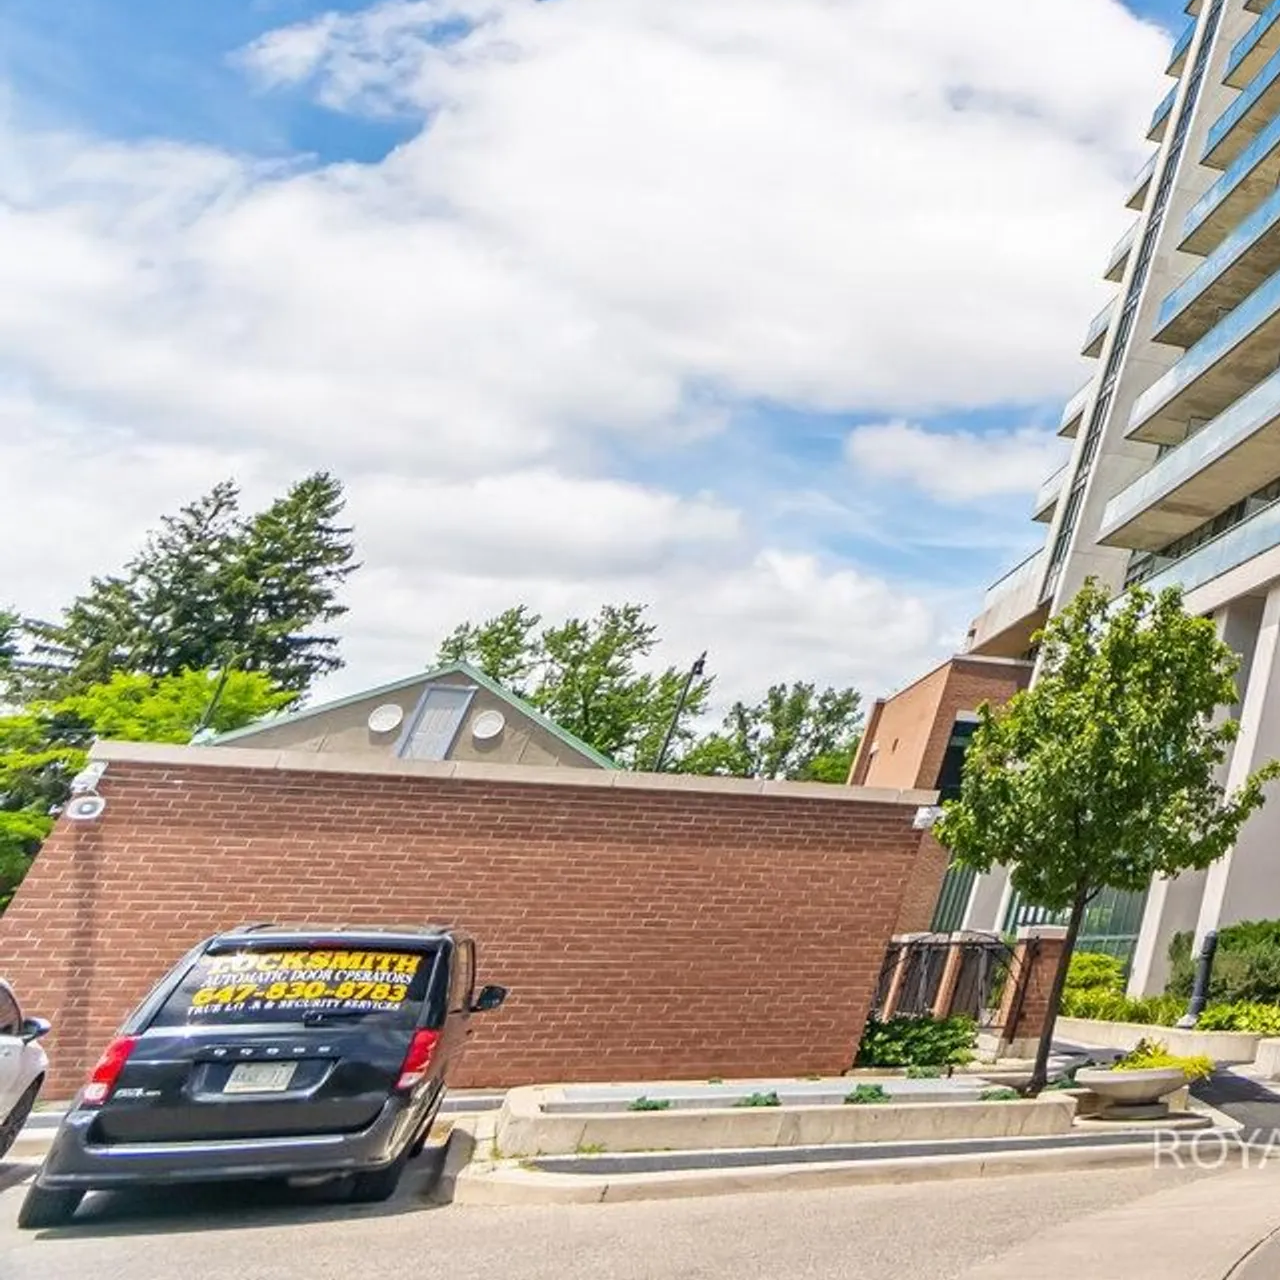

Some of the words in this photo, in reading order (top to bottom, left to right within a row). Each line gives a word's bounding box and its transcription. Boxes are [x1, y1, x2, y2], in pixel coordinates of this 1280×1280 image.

[207, 950, 422, 974] LOCKSMITH
[201, 970, 288, 987] AUTOMATIC
[290, 969, 333, 981] DOOR
[192, 981, 408, 1006] 647-830-8783
[187, 1003, 221, 1015] TRUE
[278, 998, 341, 1009] SECURITY
[342, 999, 402, 1011] SERVICES
